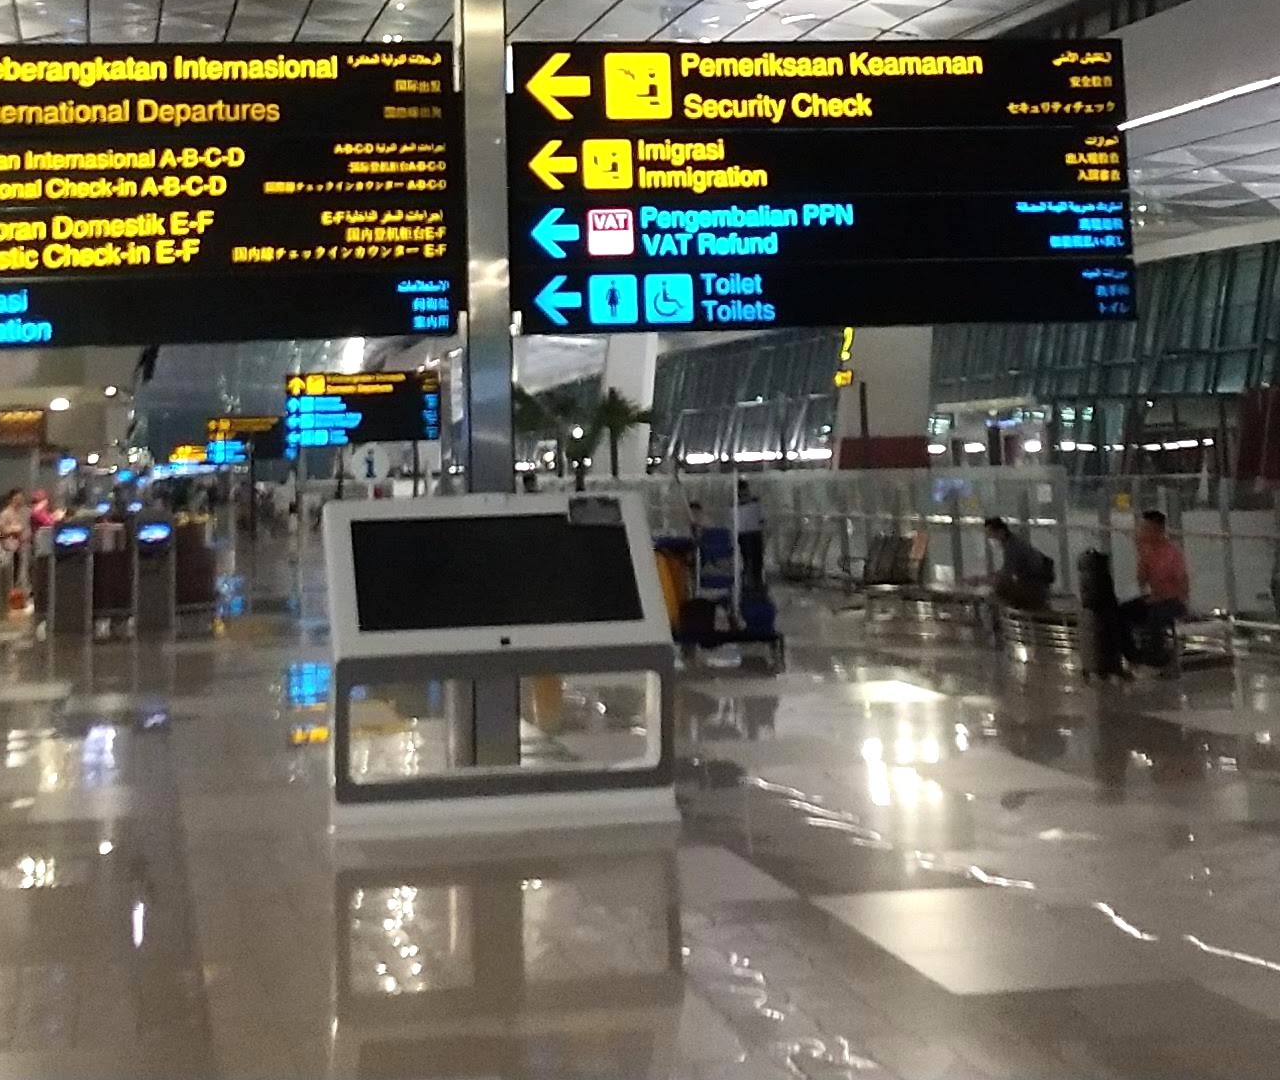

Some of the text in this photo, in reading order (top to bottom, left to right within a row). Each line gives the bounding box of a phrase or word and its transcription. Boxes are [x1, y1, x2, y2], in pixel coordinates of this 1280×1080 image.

[173, 54, 338, 81] Internasional
[680, 51, 984, 78] Pemeriksaan Keamanan
[136, 98, 281, 128] Departures
[683, 92, 873, 124] Security Check
[23, 148, 157, 172] Internasional
[158, 146, 247, 169] A-B-C-D
[637, 138, 725, 167] Imigrasi
[44, 176, 139, 200] Check-in
[140, 174, 228, 198] A-B-C-D
[638, 165, 769, 194] Immigration
[51, 211, 166, 241] Domestik
[170, 209, 216, 237] E-F
[593, 212, 629, 231] VAT
[639, 203, 855, 234] Pengembalian PPN
[41, 241, 152, 269] Check-in
[155, 237, 201, 265] E-F
[640, 231, 779, 257] VAT Refund
[699, 272, 764, 297] Toilet
[700, 298, 777, 323] Toilets
